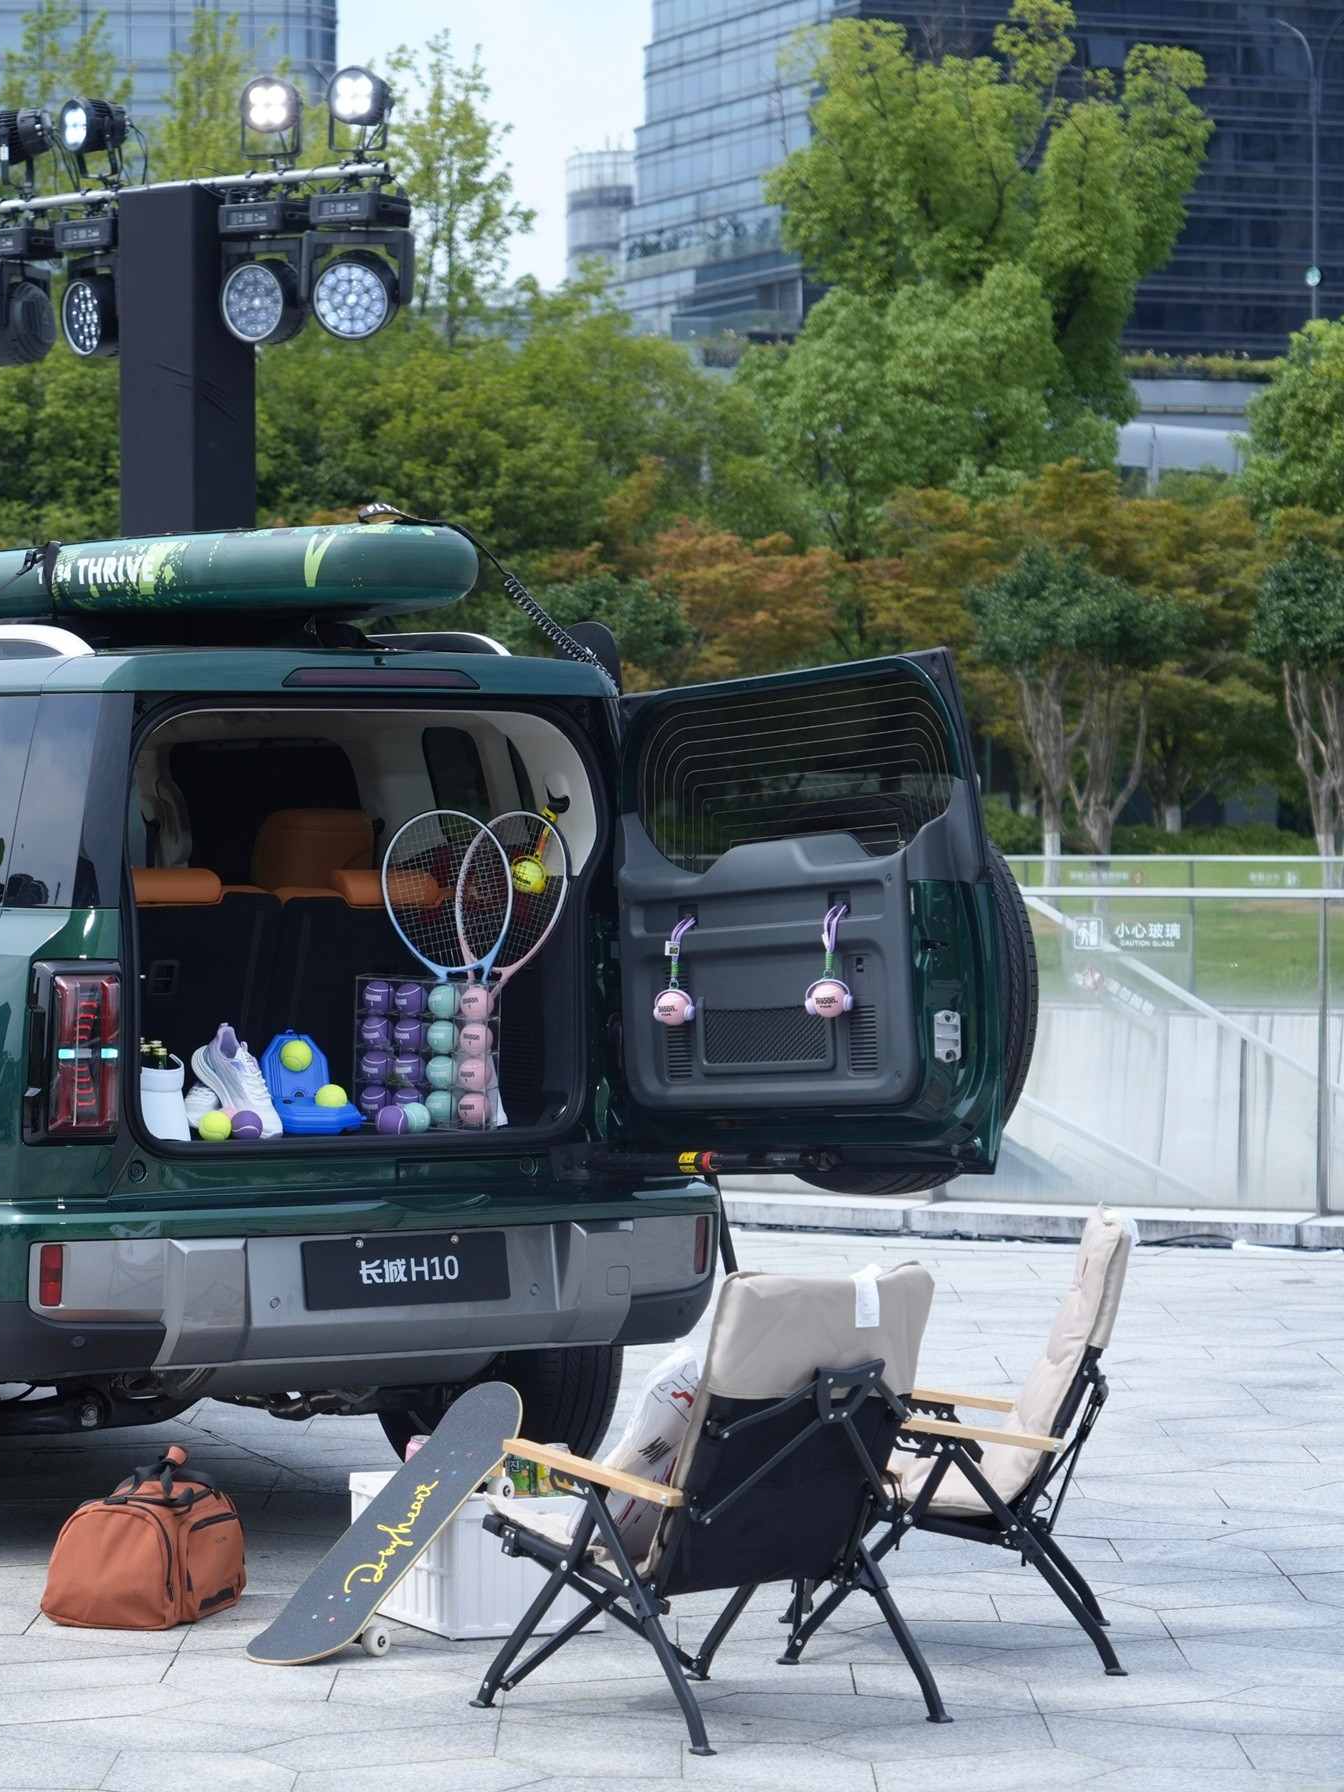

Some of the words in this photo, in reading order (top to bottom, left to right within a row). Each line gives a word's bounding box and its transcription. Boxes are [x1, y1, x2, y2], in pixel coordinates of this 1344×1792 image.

[77, 555, 156, 584] THRIVE
[1115, 922, 1181, 940] 小心玻璃
[1120, 940, 1150, 948] CAUTION
[1153, 940, 1175, 948] GLASS
[359, 1255, 460, 1284] 长城H10
